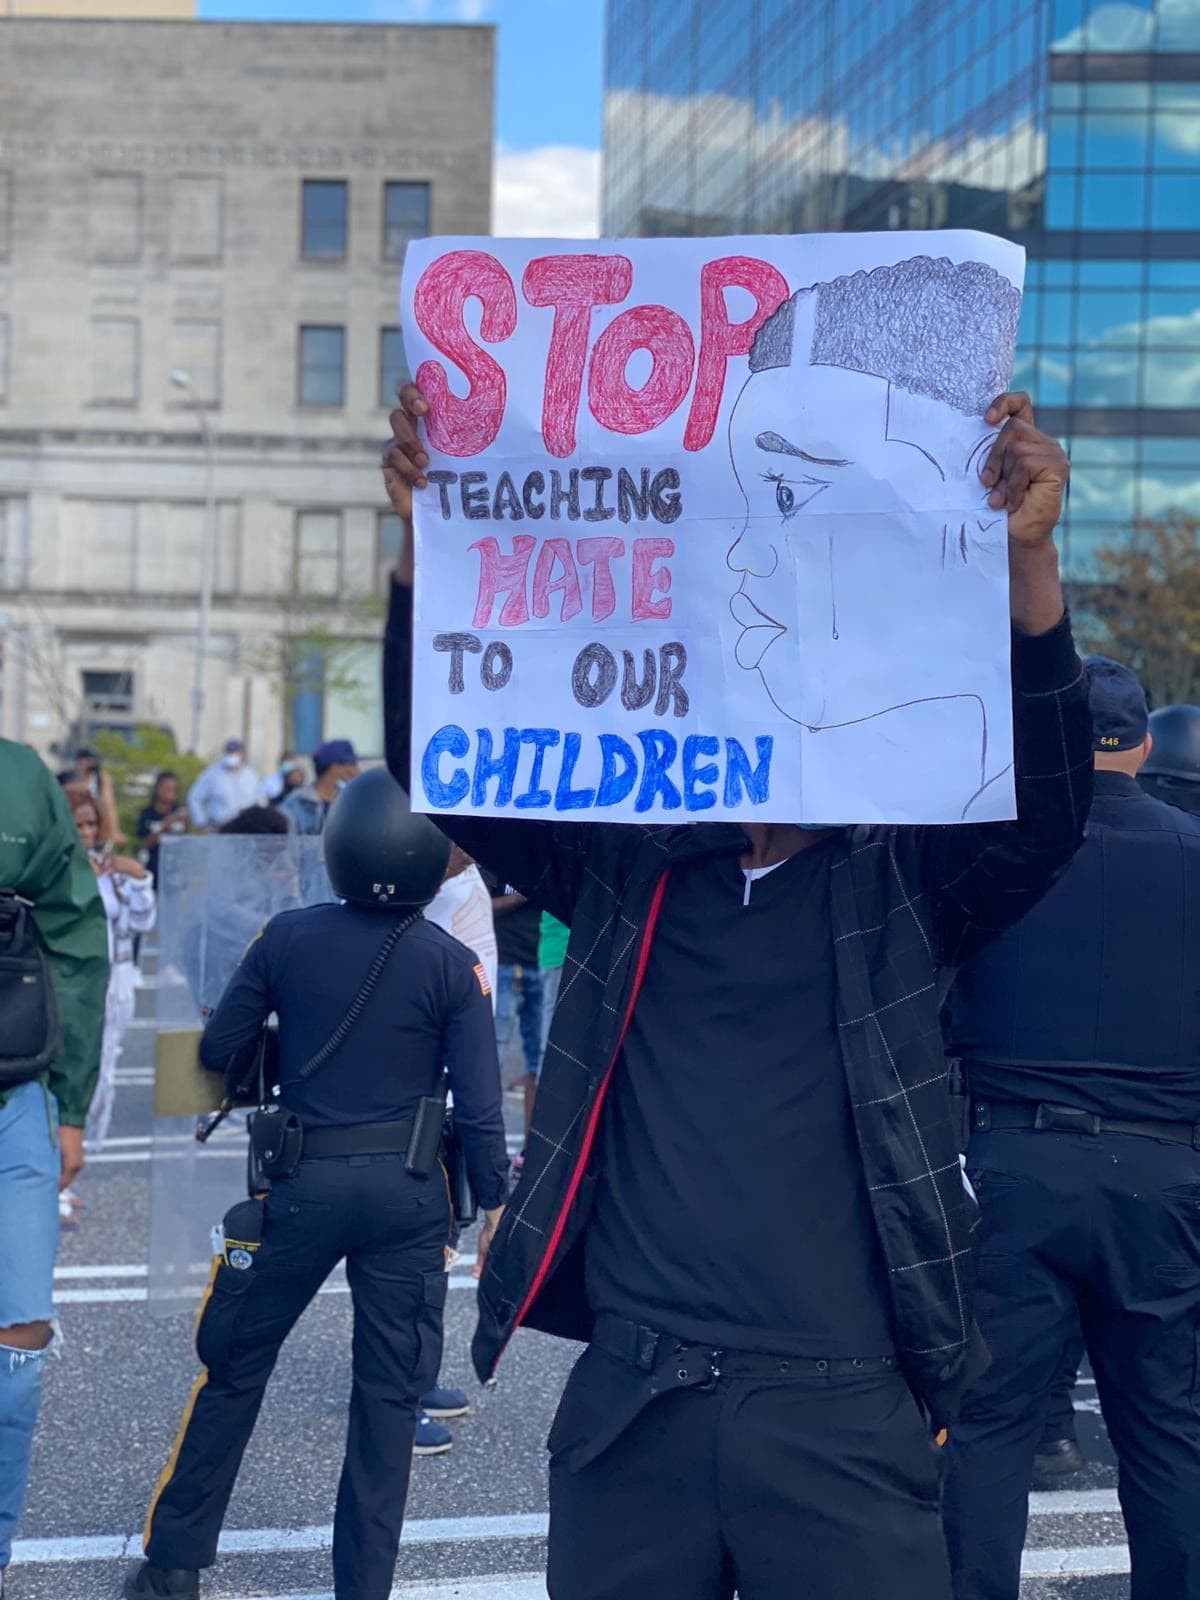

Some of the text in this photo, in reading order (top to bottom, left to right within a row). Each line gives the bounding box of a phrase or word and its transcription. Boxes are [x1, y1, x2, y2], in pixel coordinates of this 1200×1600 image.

[426, 466, 683, 524] TEACHING
[467, 534, 675, 629] HATE
[432, 633, 690, 718] TO OUR
[421, 724, 774, 813] CHILDREN
